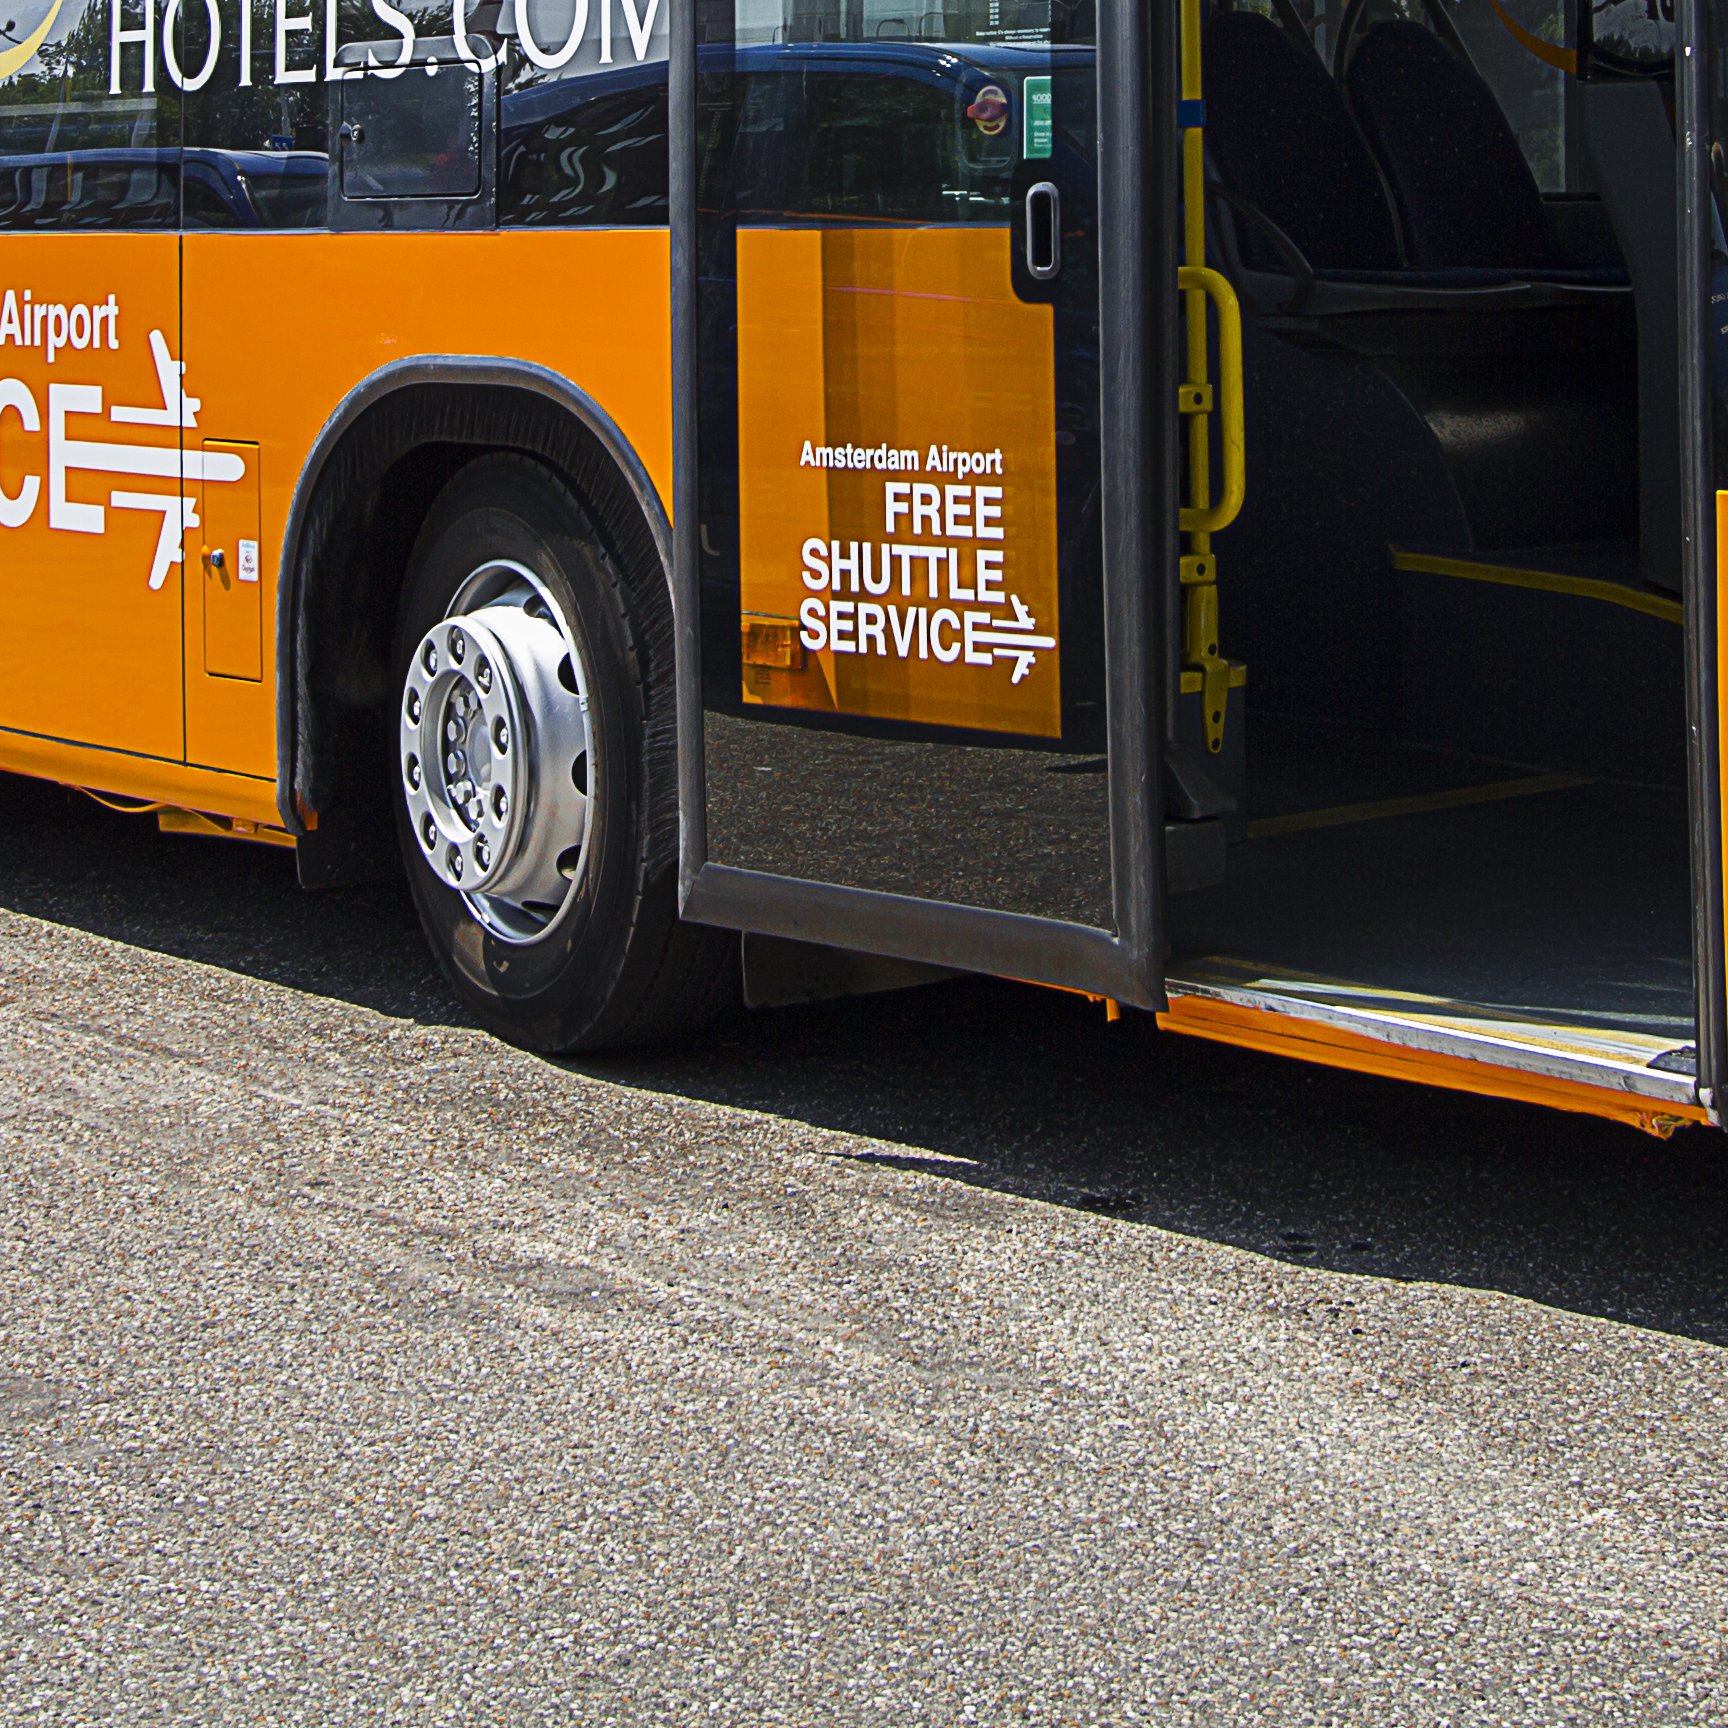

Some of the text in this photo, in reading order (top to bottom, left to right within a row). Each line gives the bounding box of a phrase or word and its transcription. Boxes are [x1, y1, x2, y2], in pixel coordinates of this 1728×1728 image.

[799, 440, 1004, 479] Amsterdam Airport
[884, 481, 1005, 540] FREE
[800, 538, 1006, 603] SHUTTLE
[799, 598, 994, 666] SERVICE
